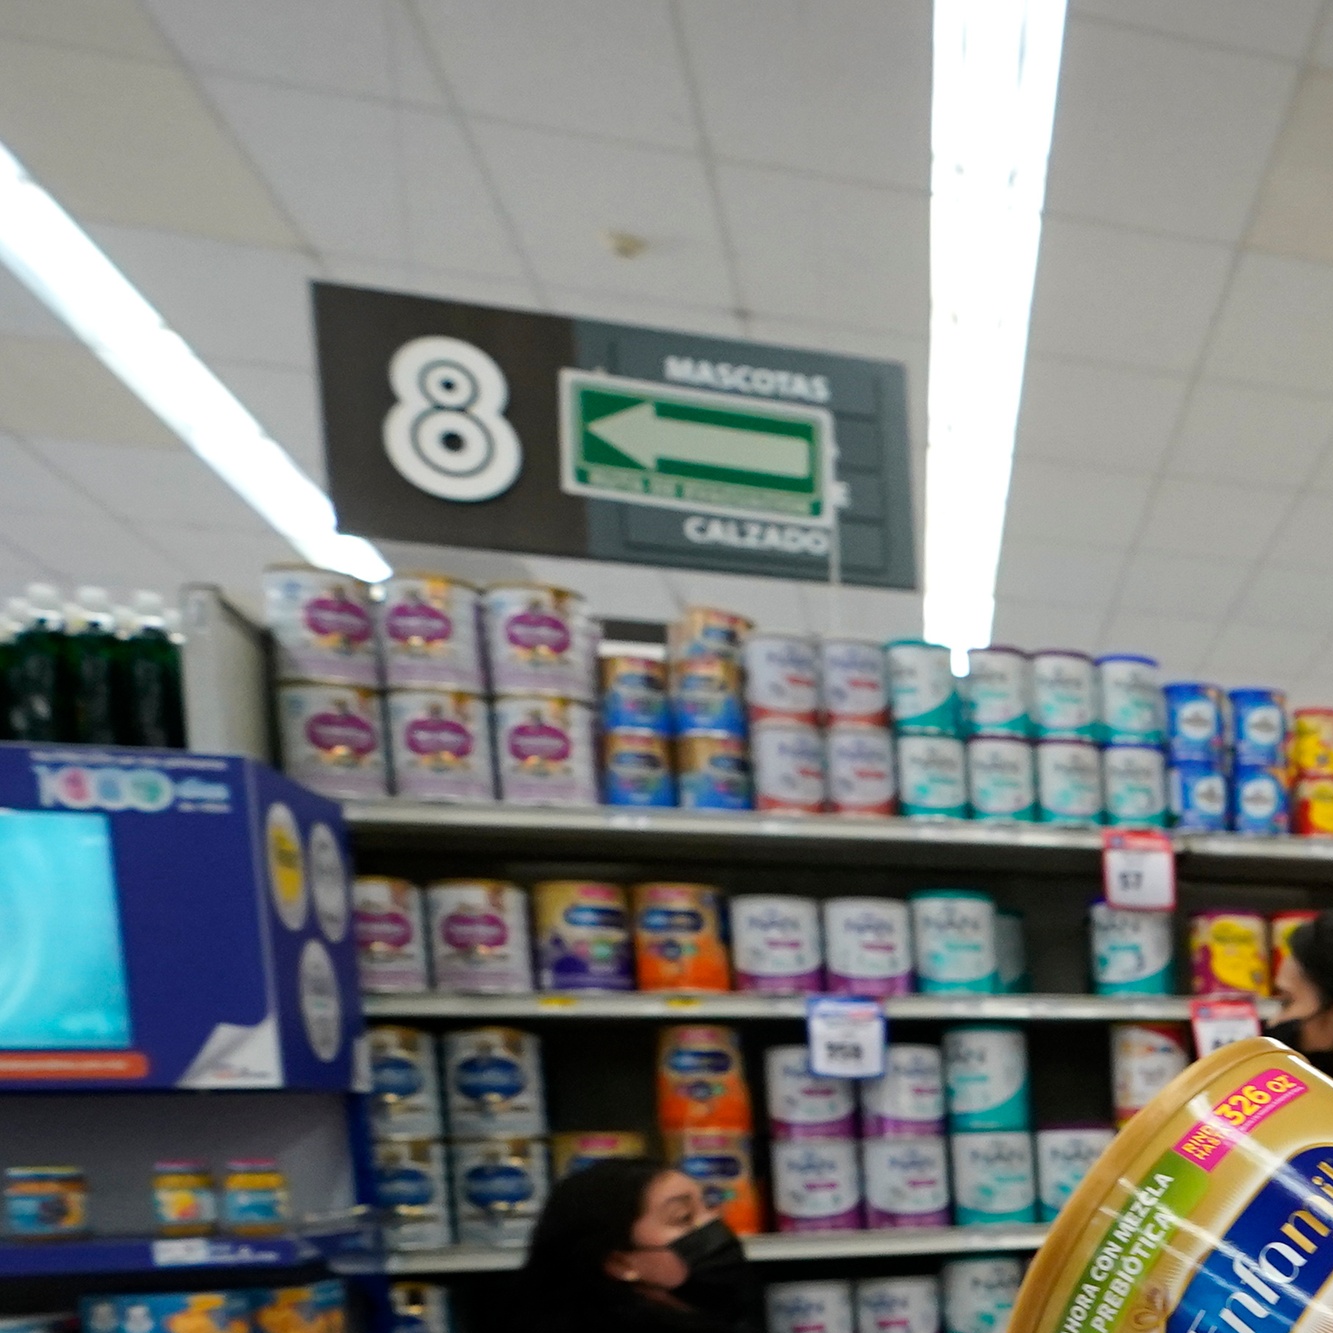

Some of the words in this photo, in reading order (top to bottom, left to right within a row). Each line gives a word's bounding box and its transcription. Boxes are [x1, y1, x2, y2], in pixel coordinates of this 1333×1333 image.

[665, 355, 829, 401] MASCOTAS
[383, 335, 524, 502] 8
[684, 515, 829, 555] CALZADO
[1215, 1085, 1271, 1126] 326
[1090, 1242, 1122, 1282] CON
[1113, 1173, 1175, 1243] MEZCLA
